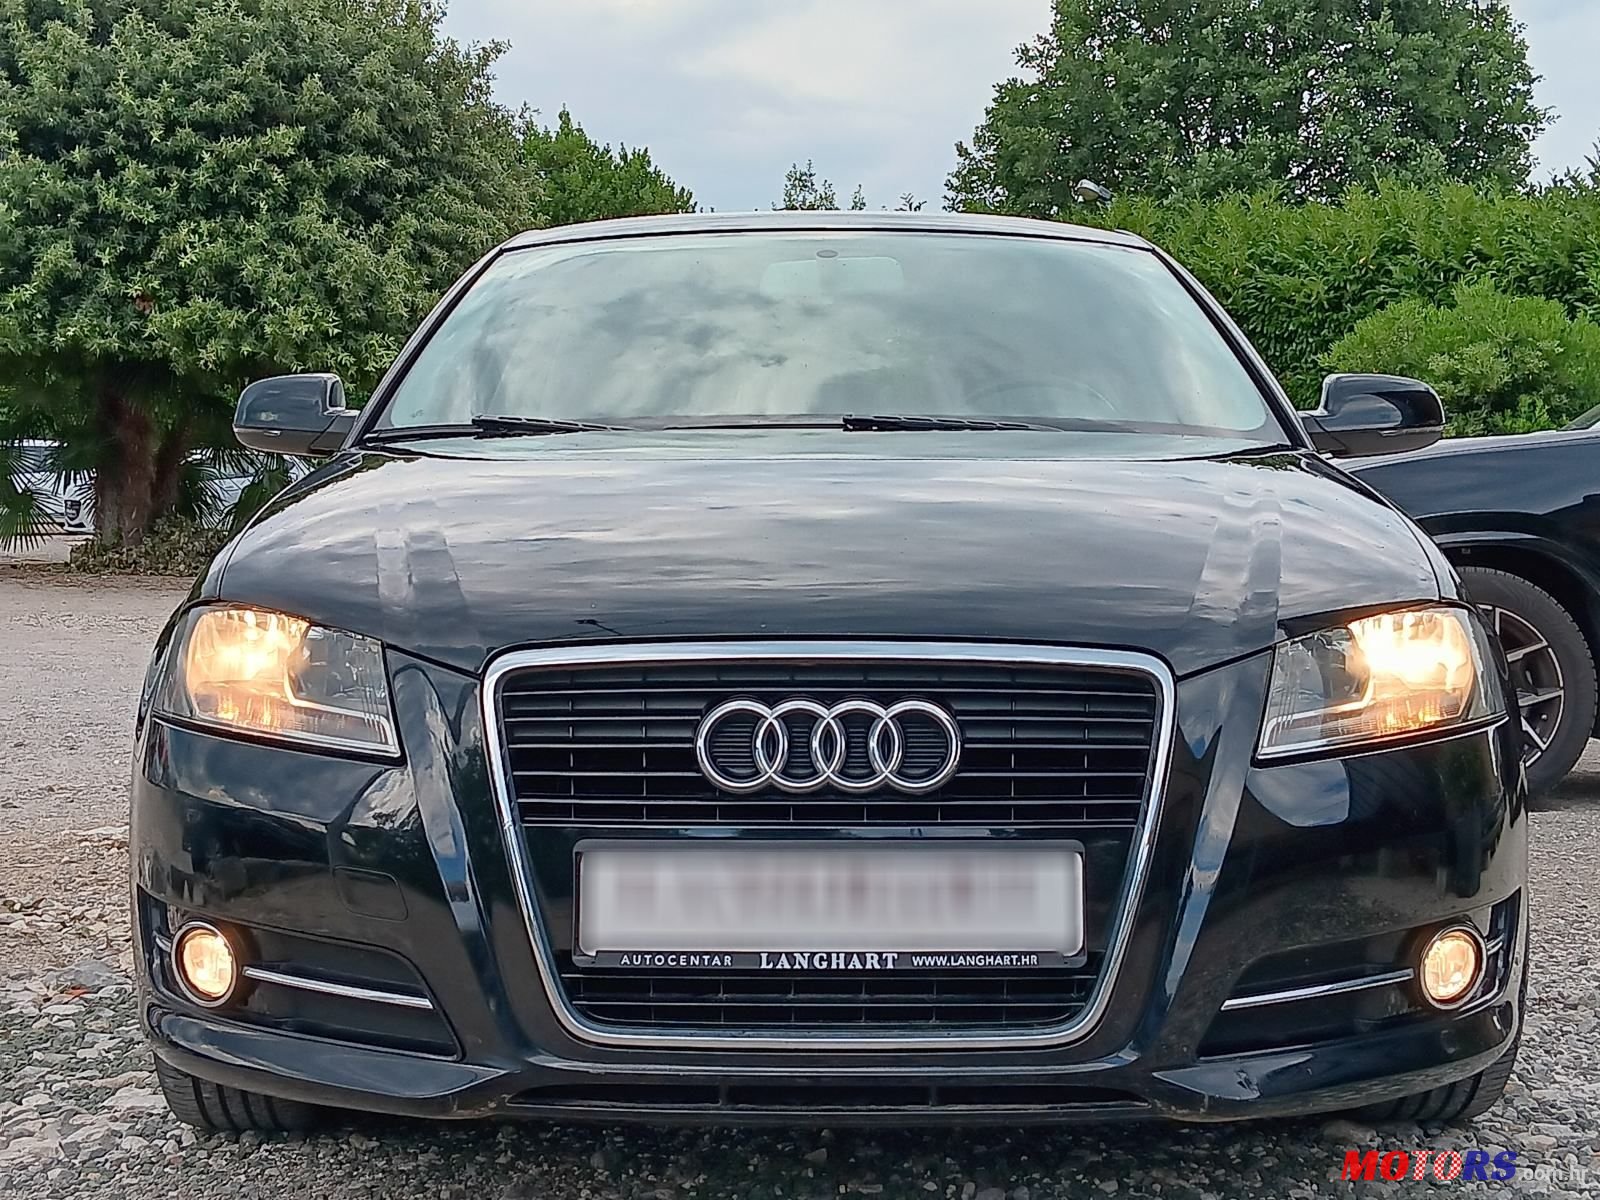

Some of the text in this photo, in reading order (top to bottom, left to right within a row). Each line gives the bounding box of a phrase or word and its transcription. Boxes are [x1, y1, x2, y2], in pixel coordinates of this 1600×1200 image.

[620, 952, 1039, 969] AUTOCENTAR LANGHART WWW.LANGHART.HR
